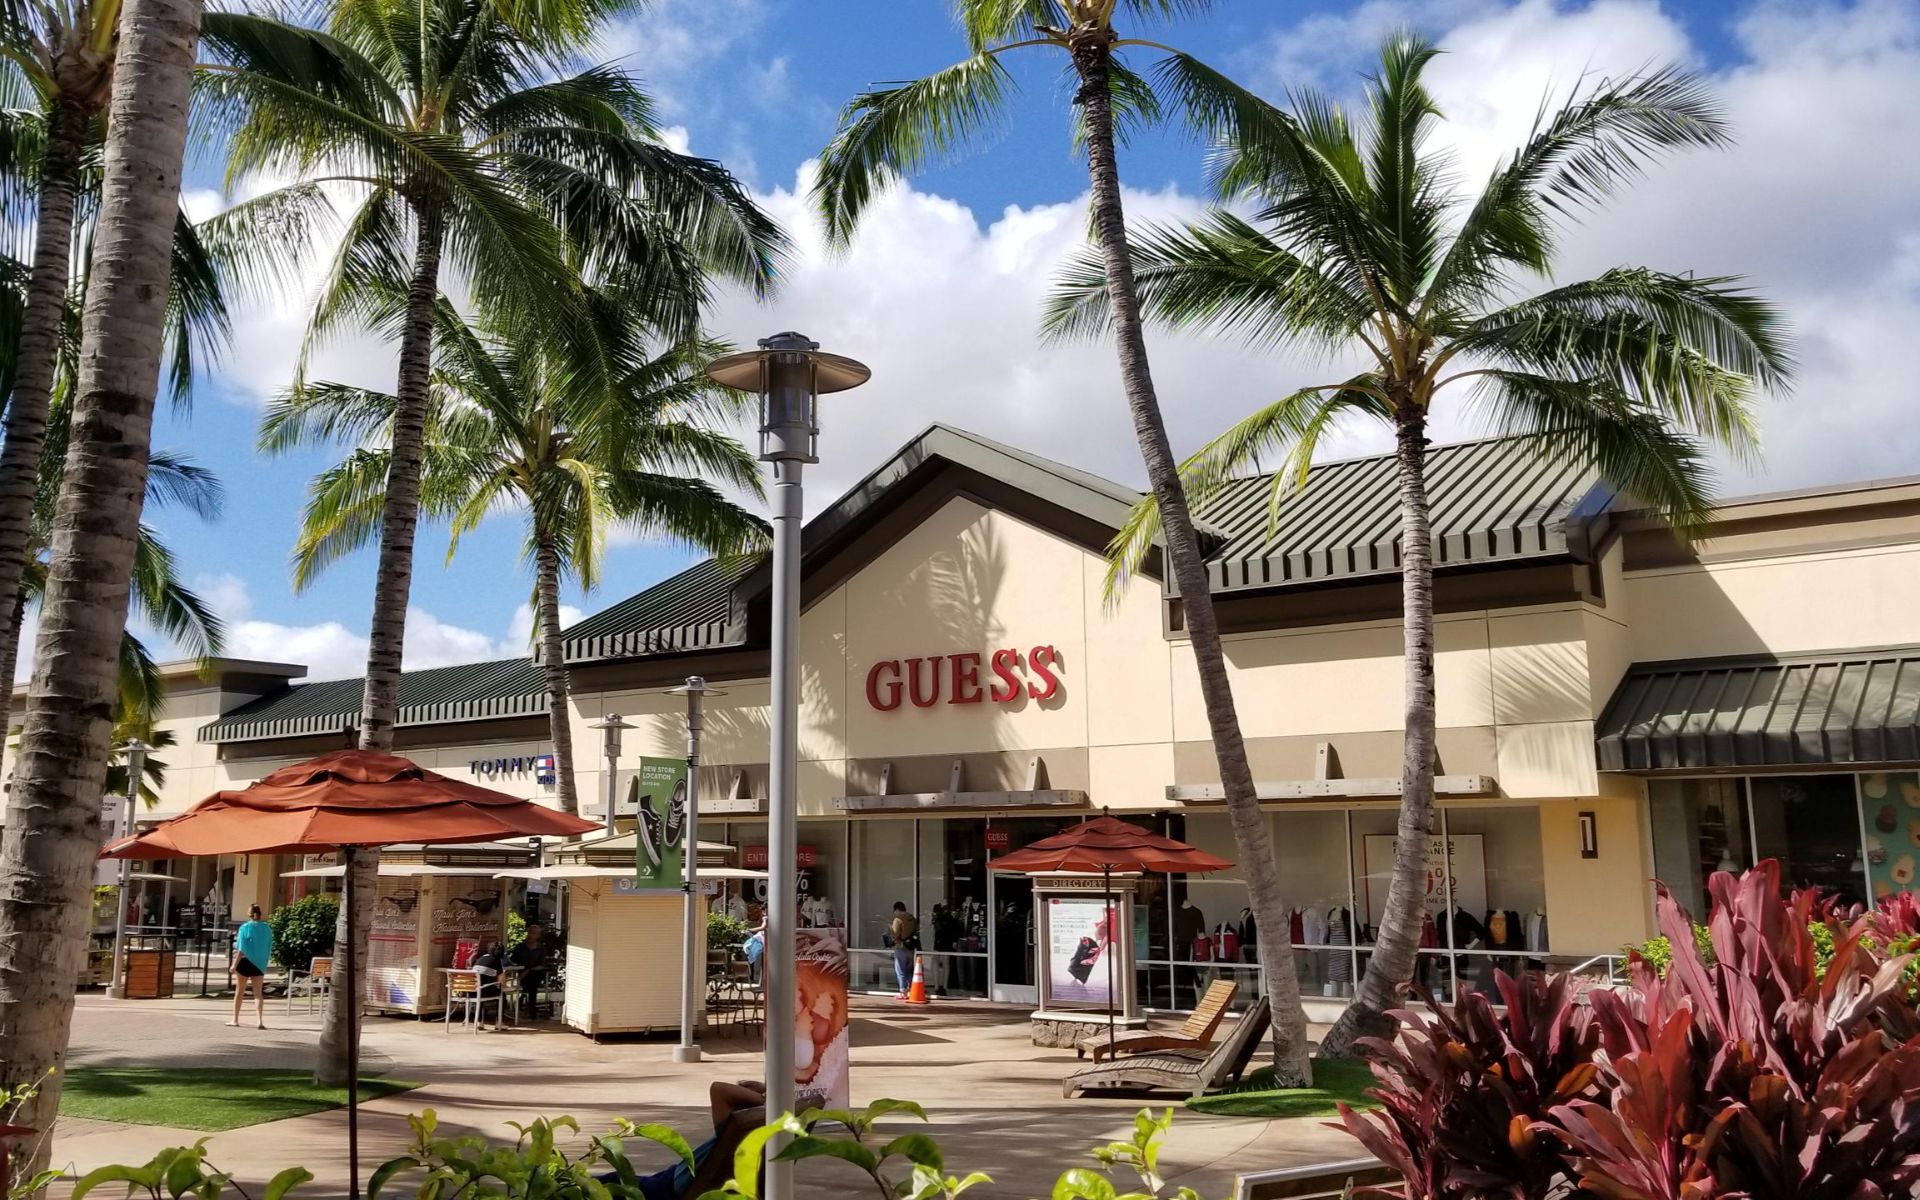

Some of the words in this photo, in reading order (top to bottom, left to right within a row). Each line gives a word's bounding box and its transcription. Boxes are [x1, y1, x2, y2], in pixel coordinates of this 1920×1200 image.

[866, 645, 1056, 712] GUESS
[468, 757, 536, 775] TOMMY
[643, 765, 657, 773] NEW
[642, 773, 671, 781] LOCATION
[987, 832, 1009, 842] GUESS
[1053, 879, 1103, 888] DIRECTORY
